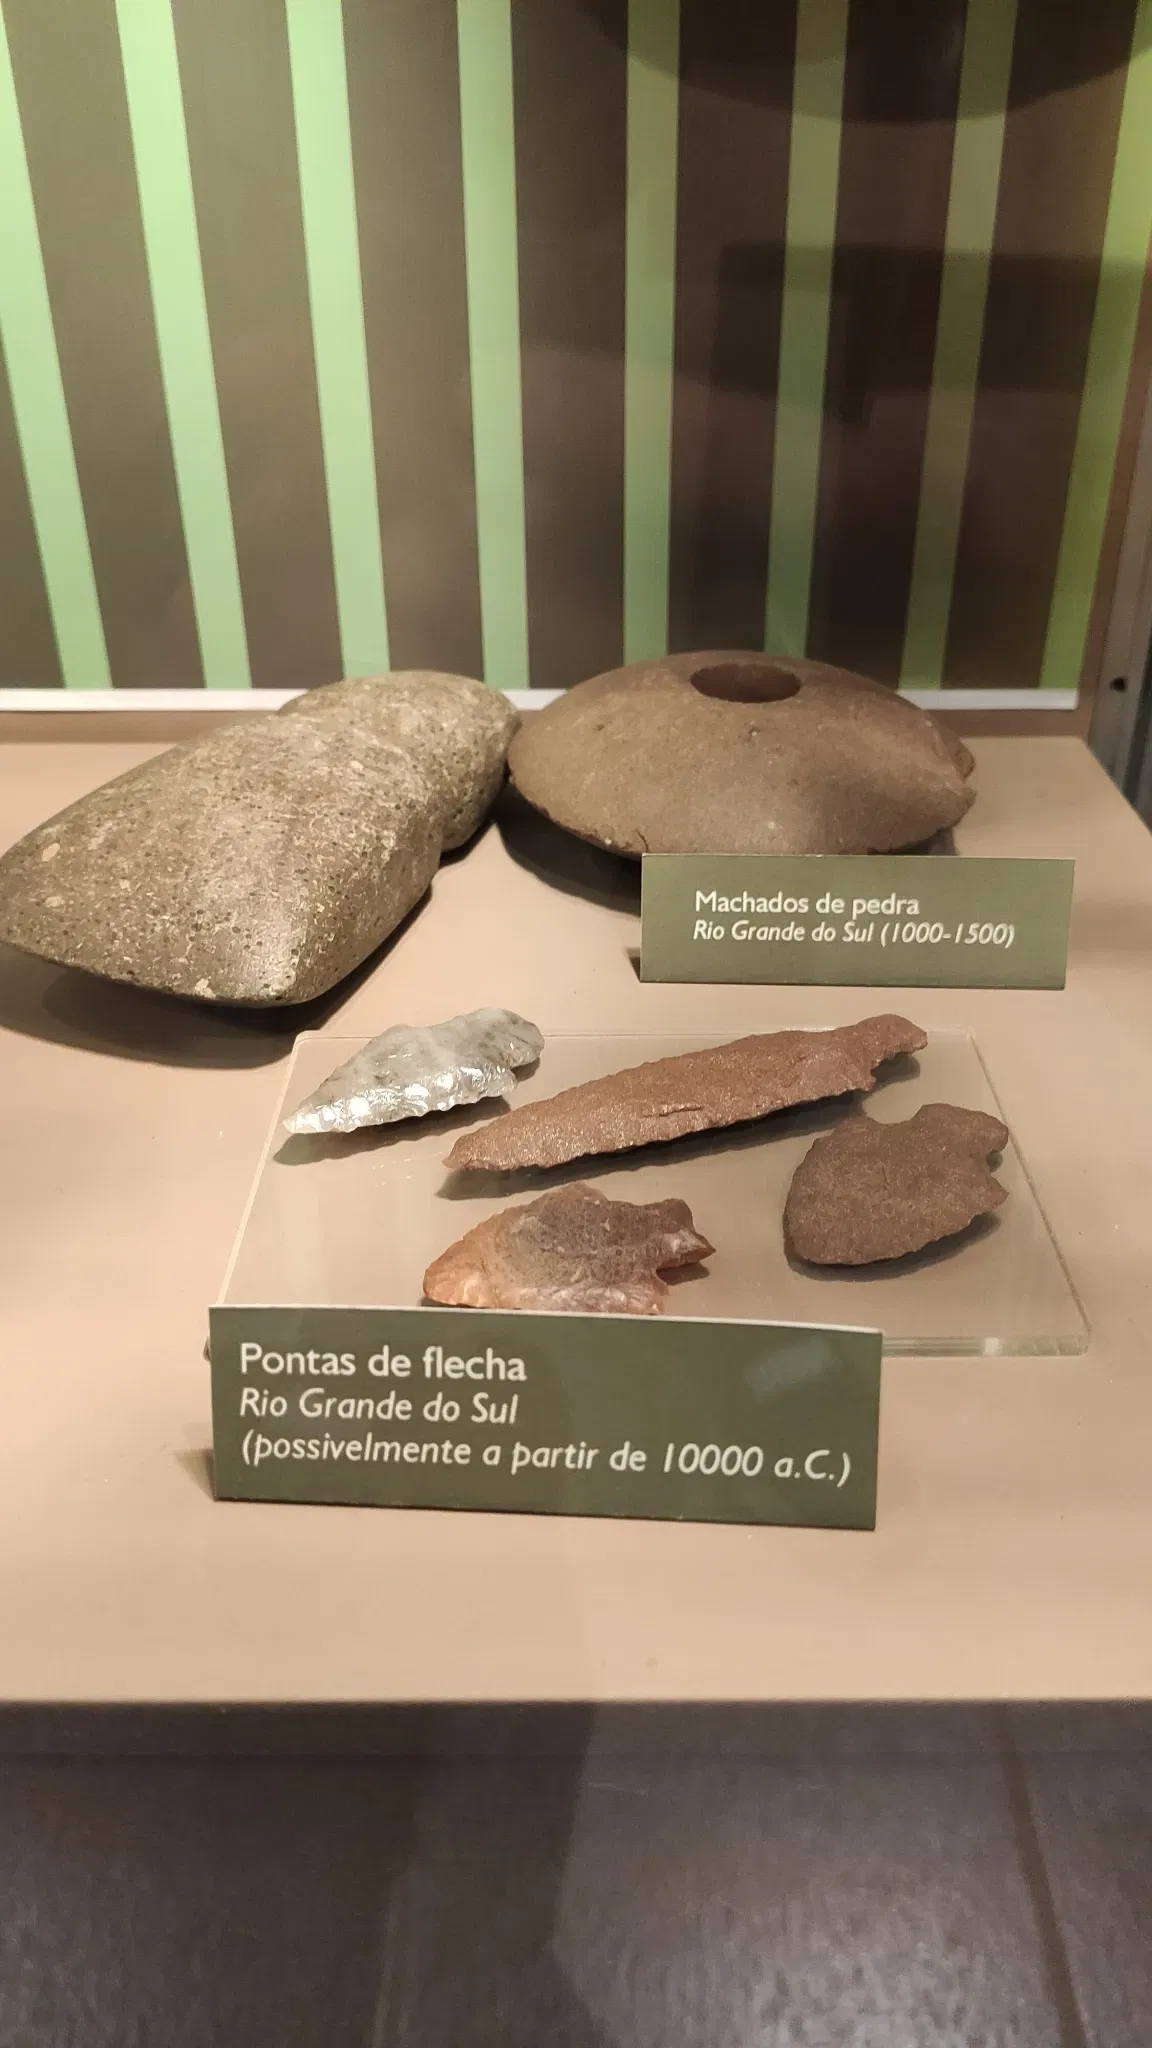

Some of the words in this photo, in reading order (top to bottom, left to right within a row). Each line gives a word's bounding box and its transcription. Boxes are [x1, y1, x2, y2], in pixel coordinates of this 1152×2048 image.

[695, 888, 809, 914] Machados
[815, 891, 845, 915] de
[851, 892, 920, 921] pedra
[692, 918, 725, 941] Rio
[730, 919, 805, 942] Grande
[810, 920, 836, 943] do
[841, 921, 875, 943] Sul
[880, 921, 1016, 950] (1000-1500)
[240, 1342, 357, 1377] Pontas
[367, 1344, 412, 1378] de
[422, 1345, 528, 1382] flecha
[239, 1387, 288, 1418] Rio
[298, 1387, 412, 1421] Grande
[422, 1391, 461, 1422] do
[470, 1391, 519, 1425] Sul
[242, 1429, 472, 1467] (possivelmente
[482, 1445, 502, 1466] a
[510, 1440, 599, 1475] partir
[609, 1440, 647, 1472] de
[663, 1442, 764, 1477] 10000
[774, 1449, 851, 1488] a.C.)
